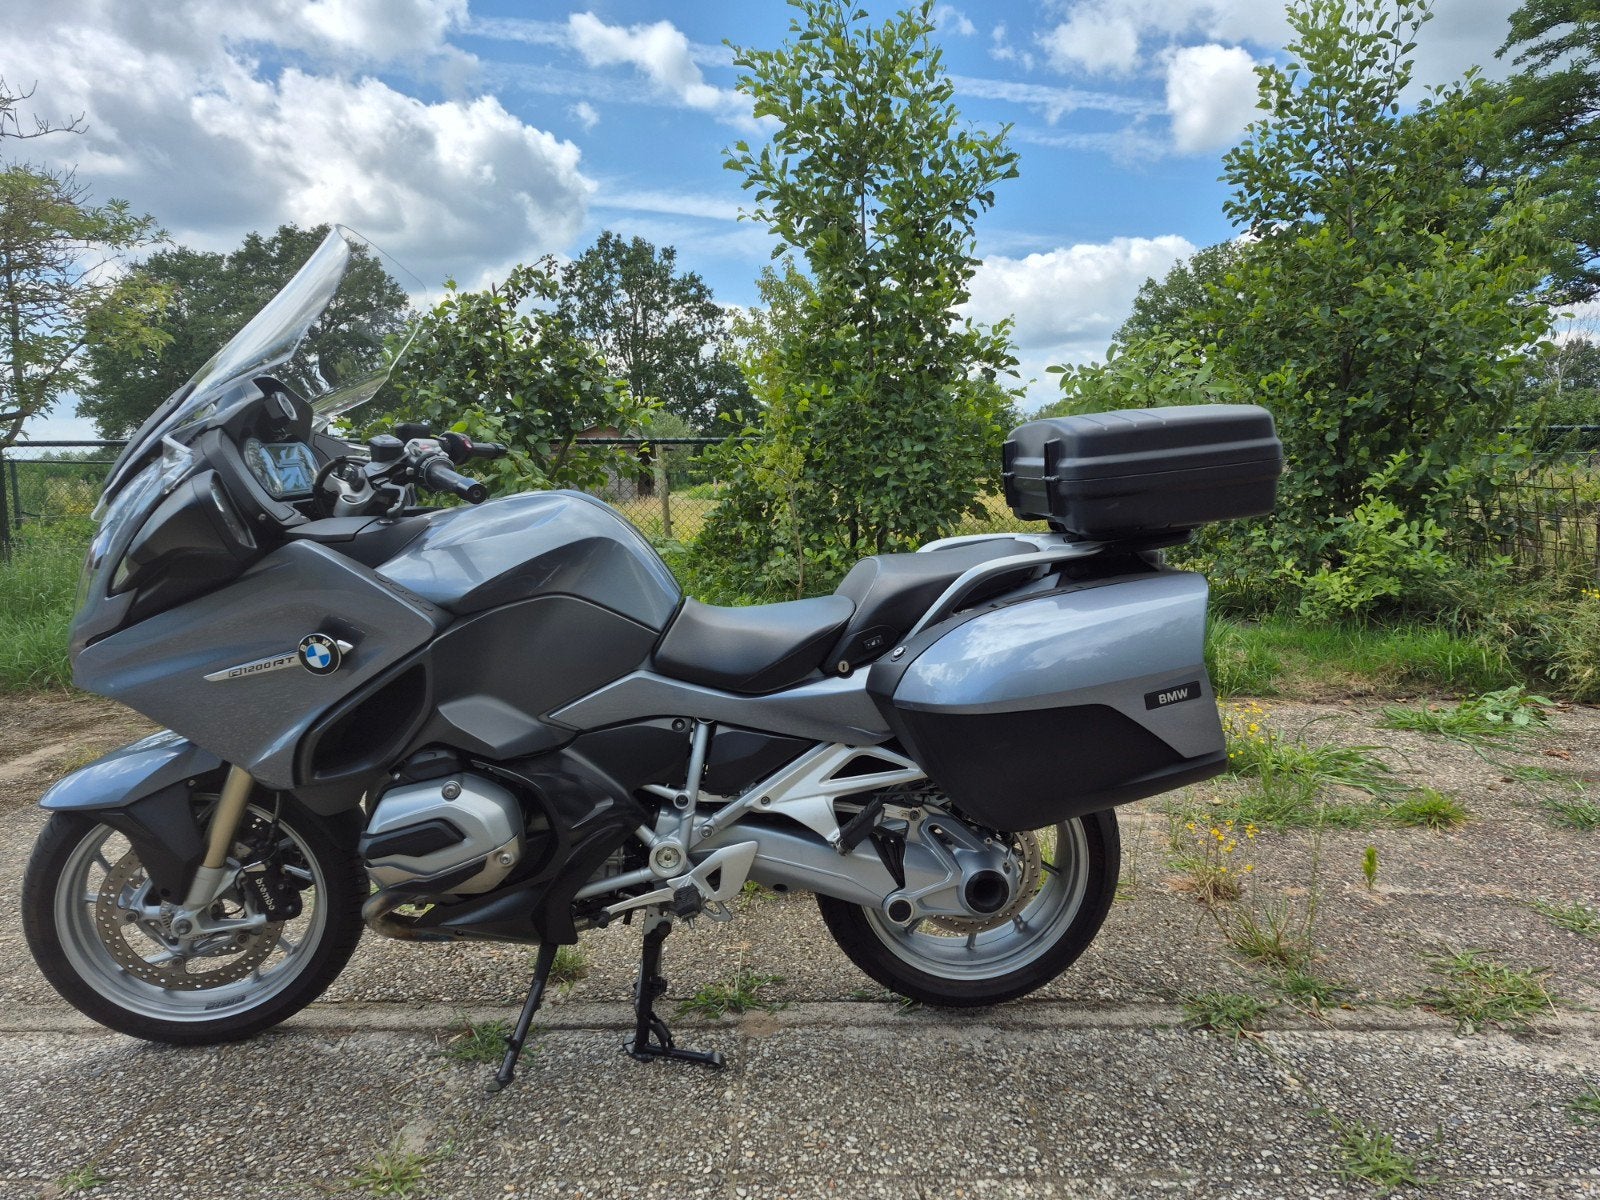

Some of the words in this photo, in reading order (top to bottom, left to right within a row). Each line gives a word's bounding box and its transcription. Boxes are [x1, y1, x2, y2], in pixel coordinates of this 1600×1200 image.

[299, 636, 332, 652] BMW
[1158, 687, 1188, 704] BMW
[255, 877, 275, 910] brembo
